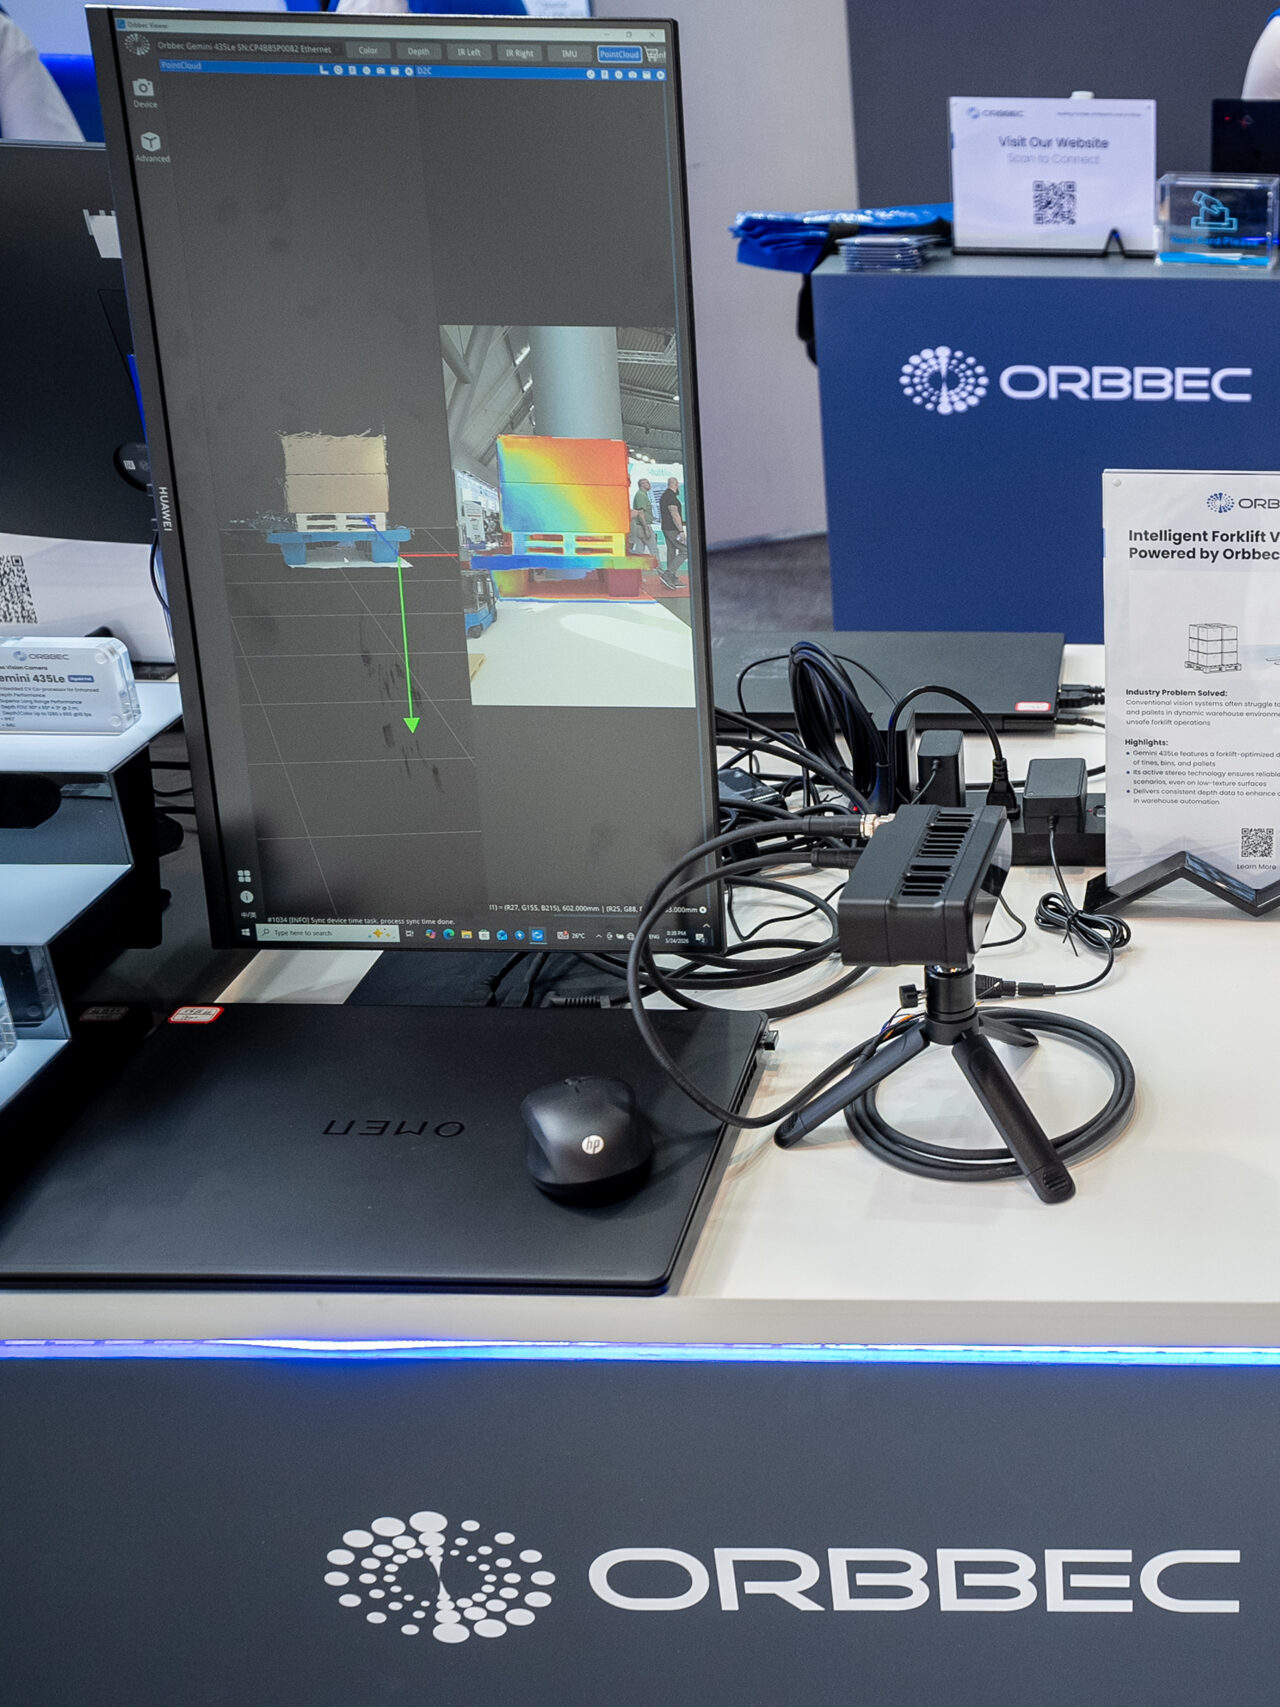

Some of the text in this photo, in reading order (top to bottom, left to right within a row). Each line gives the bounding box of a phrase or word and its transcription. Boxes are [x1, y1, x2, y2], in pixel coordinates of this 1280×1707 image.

[157, 41, 184, 49] Orbbec
[186, 42, 212, 50] Gemini
[214, 42, 236, 51] 435Le
[300, 45, 332, 53] Ethernet
[359, 46, 377, 55] Color
[408, 47, 430, 57] Depth
[466, 48, 481, 57] Left
[506, 49, 533, 59] IR Right
[600, 50, 639, 59] PointCloud
[161, 62, 202, 70] PointCloud
[417, 67, 431, 75] D2C
[999, 136, 1110, 148] Visit Our Website
[1007, 153, 1100, 164] Scan to Connect
[1000, 365, 1252, 402] ORBBEC
[158, 486, 173, 531] HUAWEI
[1128, 530, 1208, 545] Intelligent
[1212, 530, 1266, 543] Forklift
[1129, 547, 1196, 560] Powered
[1200, 548, 1219, 563] by
[1223, 548, 1280, 561] Orbbec
[0, 674, 30, 683] emini
[33, 674, 65, 683] 435Le
[1125, 689, 1160, 697] Industry
[322, 1120, 465, 1137] OMEN
[586, 1136, 600, 1154] hp
[588, 1547, 1241, 1613] ORBBEC
